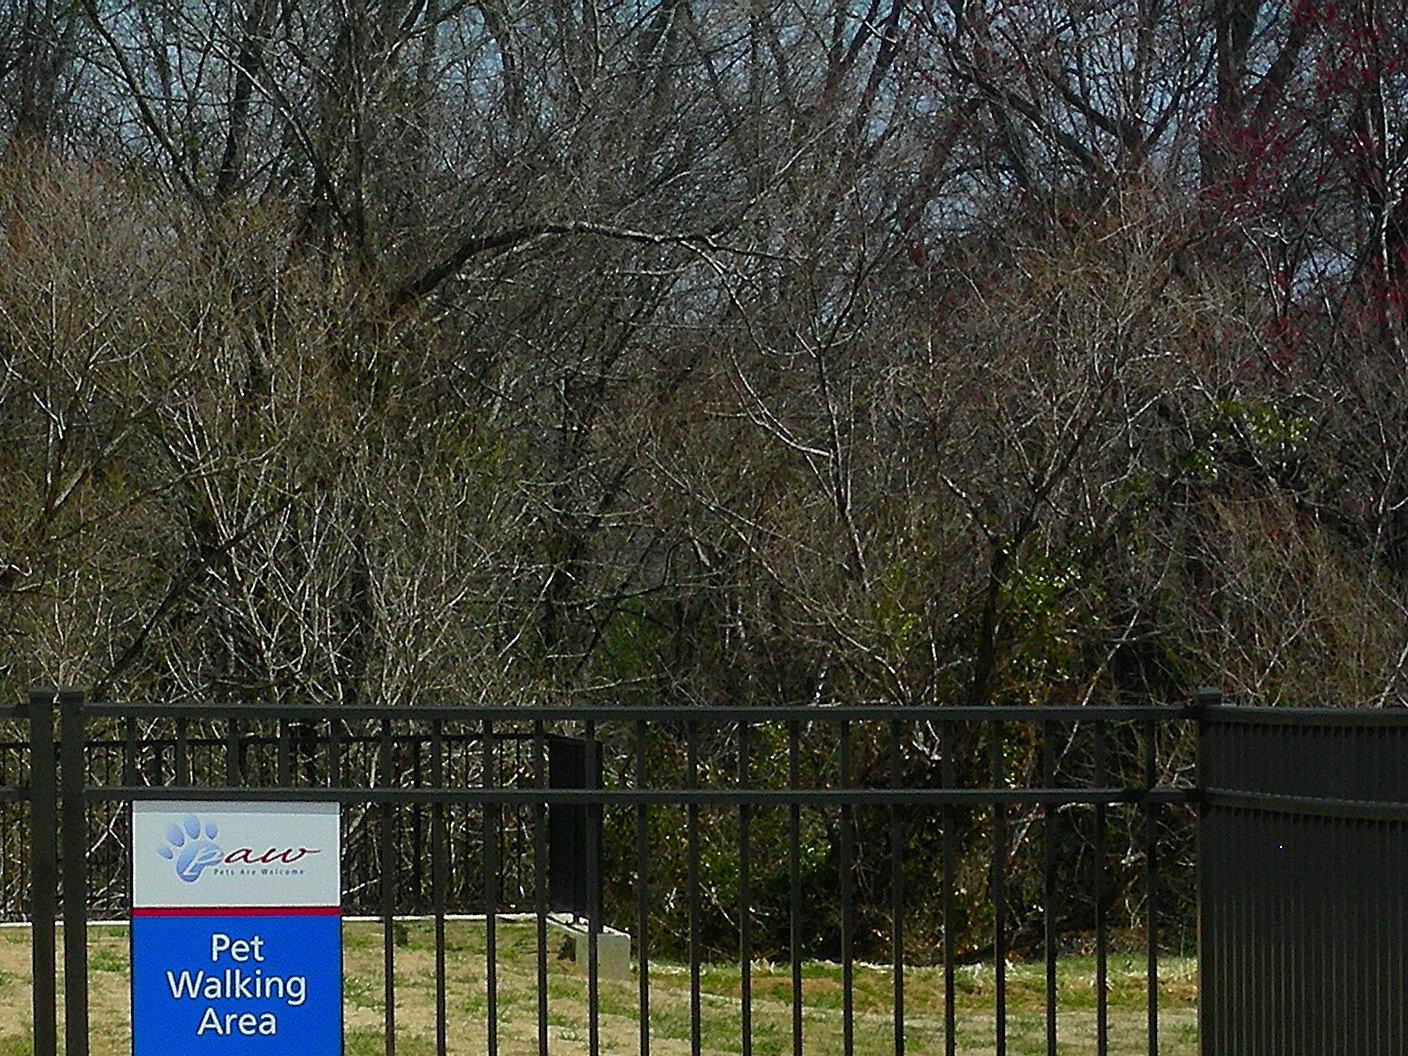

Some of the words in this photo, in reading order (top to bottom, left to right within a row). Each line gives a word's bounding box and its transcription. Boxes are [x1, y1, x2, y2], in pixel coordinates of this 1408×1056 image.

[214, 868, 234, 876] Pets
[241, 868, 256, 876] Are
[261, 868, 304, 876] Welcome
[211, 934, 265, 962] Pet
[166, 969, 308, 1006] Walking
[196, 1008, 277, 1036] Area
